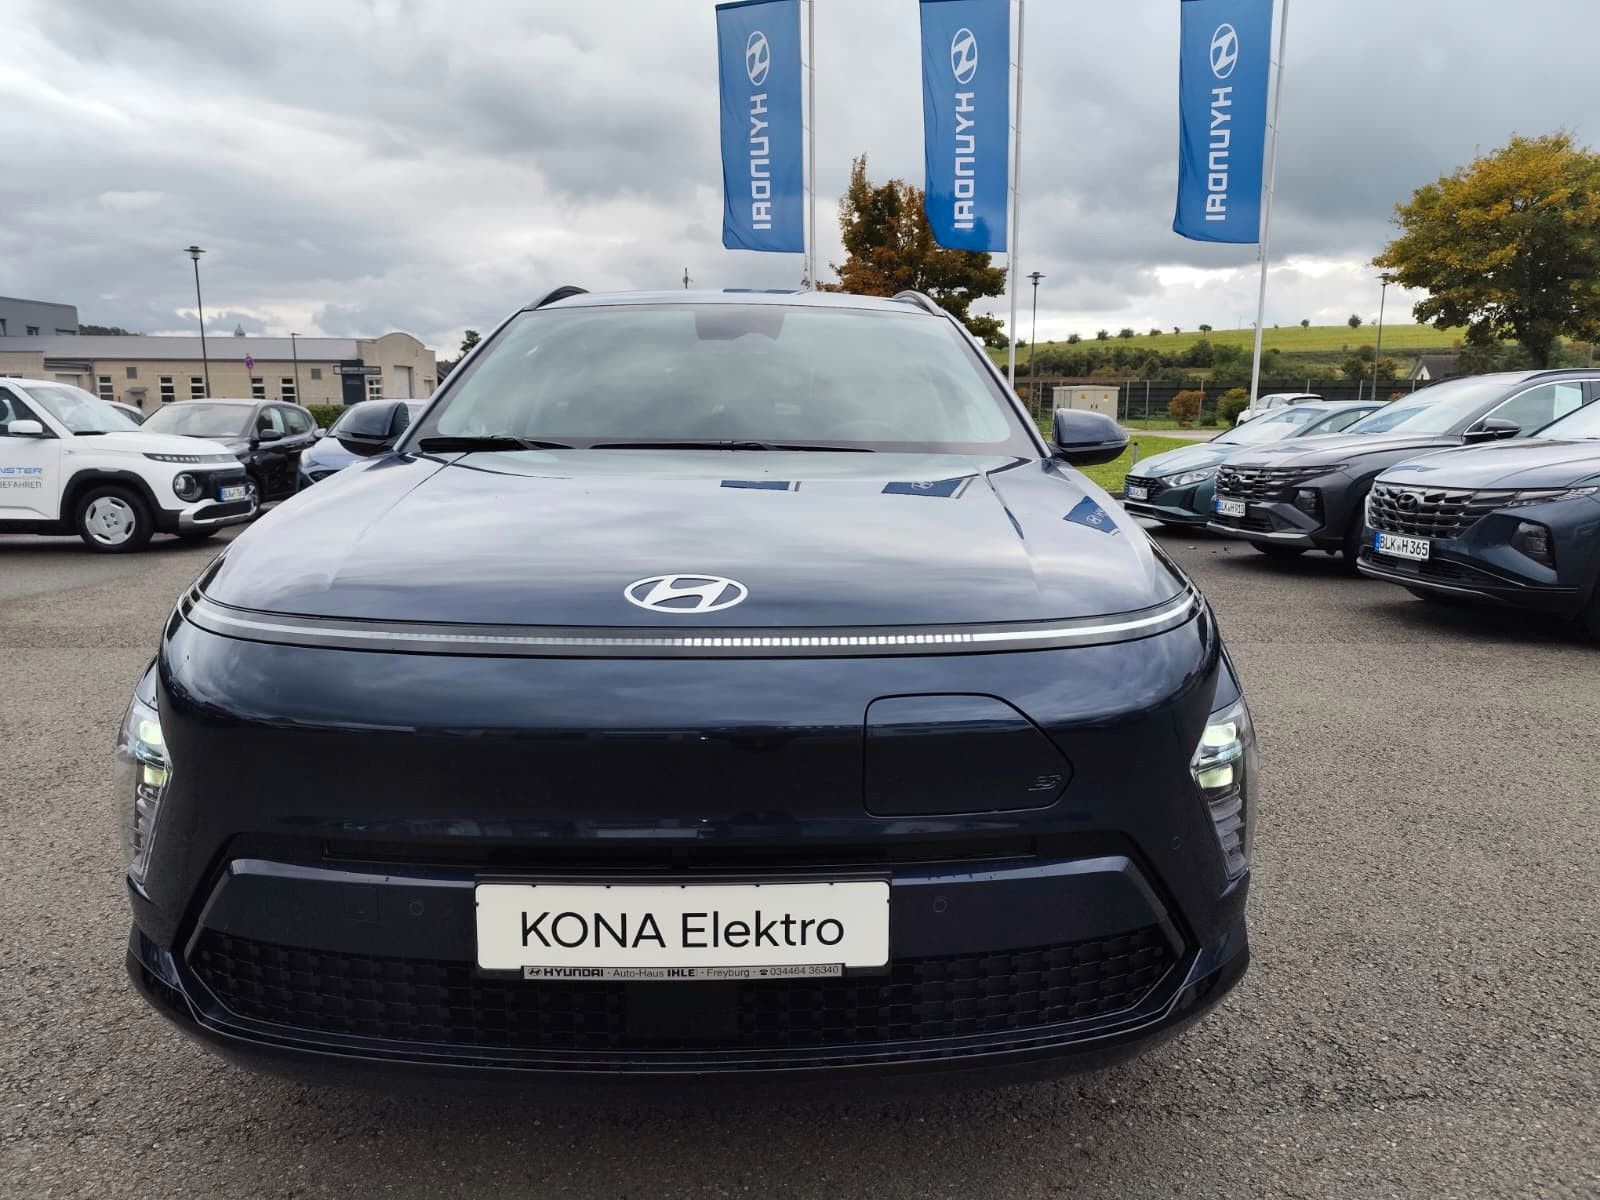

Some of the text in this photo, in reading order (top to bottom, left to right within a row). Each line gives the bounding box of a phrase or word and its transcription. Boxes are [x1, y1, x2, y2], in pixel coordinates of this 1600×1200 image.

[1380, 535, 1396, 551] BLK
[521, 910, 845, 948] KONA Elektro
[543, 965, 839, 978] HYUNDAI Auto-Haus IHLE Freyburg 034464 36340
